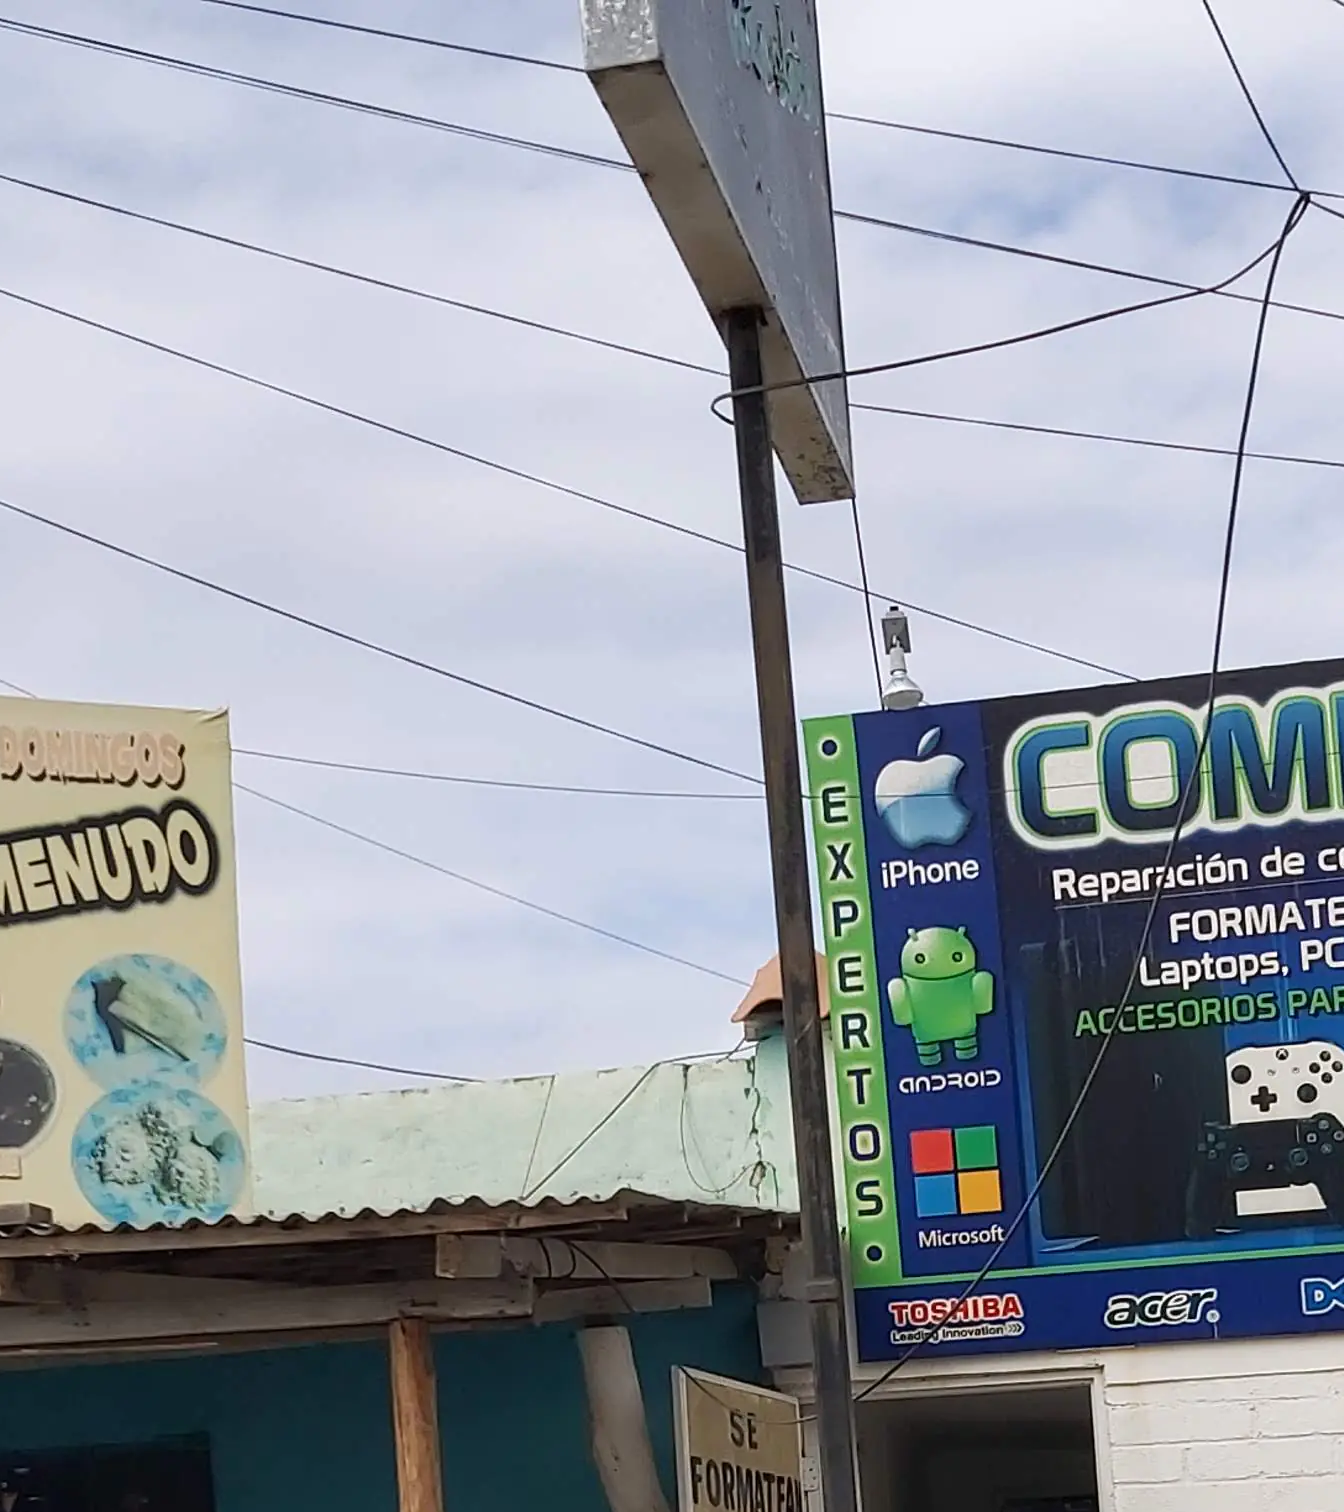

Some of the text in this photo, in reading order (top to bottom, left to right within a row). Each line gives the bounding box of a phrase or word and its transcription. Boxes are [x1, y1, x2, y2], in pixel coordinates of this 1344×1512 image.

[880, 856, 981, 889] iPhone
[1052, 851, 1249, 902] Reparación
[1261, 846, 1305, 880] de
[1138, 950, 1290, 992] Laptops,
[819, 783, 887, 1221] EXPERTOS
[1074, 987, 1277, 1039] ACCESORIOS
[918, 1223, 1006, 1249] Microsoft
[889, 1294, 1025, 1326] TOSHIBA
[1105, 1288, 1218, 1329] acer
[942, 1324, 1005, 1340] Innovation
[728, 1409, 760, 1452] SE
